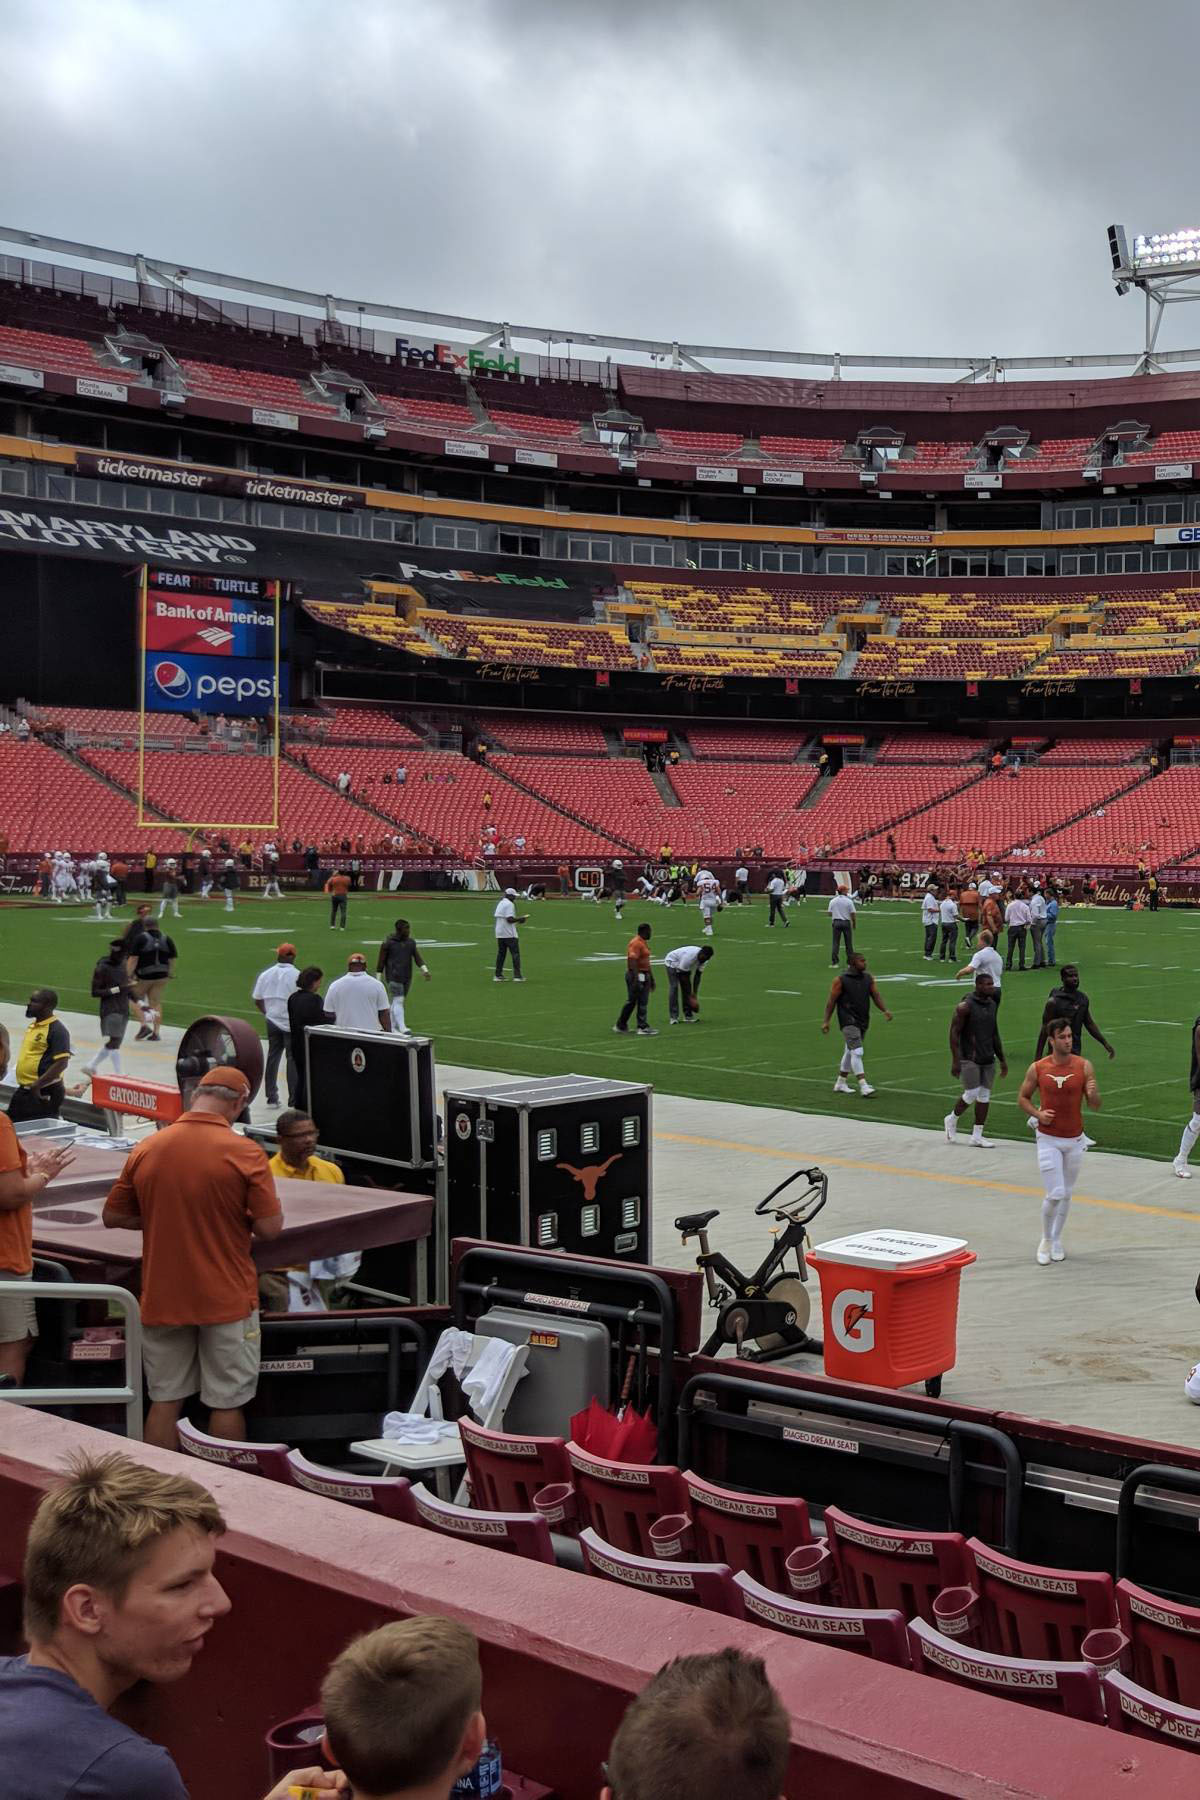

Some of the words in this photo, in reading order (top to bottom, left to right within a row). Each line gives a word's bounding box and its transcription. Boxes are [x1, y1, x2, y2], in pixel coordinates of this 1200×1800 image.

[395, 338, 520, 375] FedExField
[79, 386, 113, 398] COLEMAN
[97, 458, 205, 487] ticketmaster
[246, 479, 348, 506] ticketmaster
[14, 525, 222, 563] LOTTERY
[399, 562, 570, 590] FedExField
[156, 602, 196, 619] Bank
[196, 607, 211, 620] of
[214, 607, 275, 626] America
[197, 674, 278, 702] pepsi
[580, 872, 600, 886] 40
[1120, 889, 1130, 901] to
[1130, 886, 1150, 903] the
[109, 1086, 157, 1111] GATORADE
[831, 1288, 875, 1353] G
[287, 1361, 312, 1370] SEATS
[508, 1442, 535, 1454] SEATS
[810, 1433, 836, 1448] DREAM
[837, 1439, 857, 1452] SEATS
[341, 1487, 371, 1499] SEATS
[713, 1496, 744, 1514] DREAM
[746, 1504, 775, 1517] SEATS
[472, 1521, 505, 1534] SEATS
[617, 1565, 653, 1586] DREAM
[656, 1573, 692, 1587] SEATS
[975, 1555, 1004, 1577] DIAGEO
[1004, 1568, 1041, 1588] DREAM
[1043, 1579, 1075, 1593] SEATS
[777, 1610, 819, 1632] DREAM
[822, 1619, 862, 1633] SEATS
[1131, 1600, 1166, 1622] DIAGEO
[922, 1642, 960, 1670] DIAGEO
[962, 1660, 1008, 1683] DREAM
[1011, 1670, 1055, 1686] SEATS
